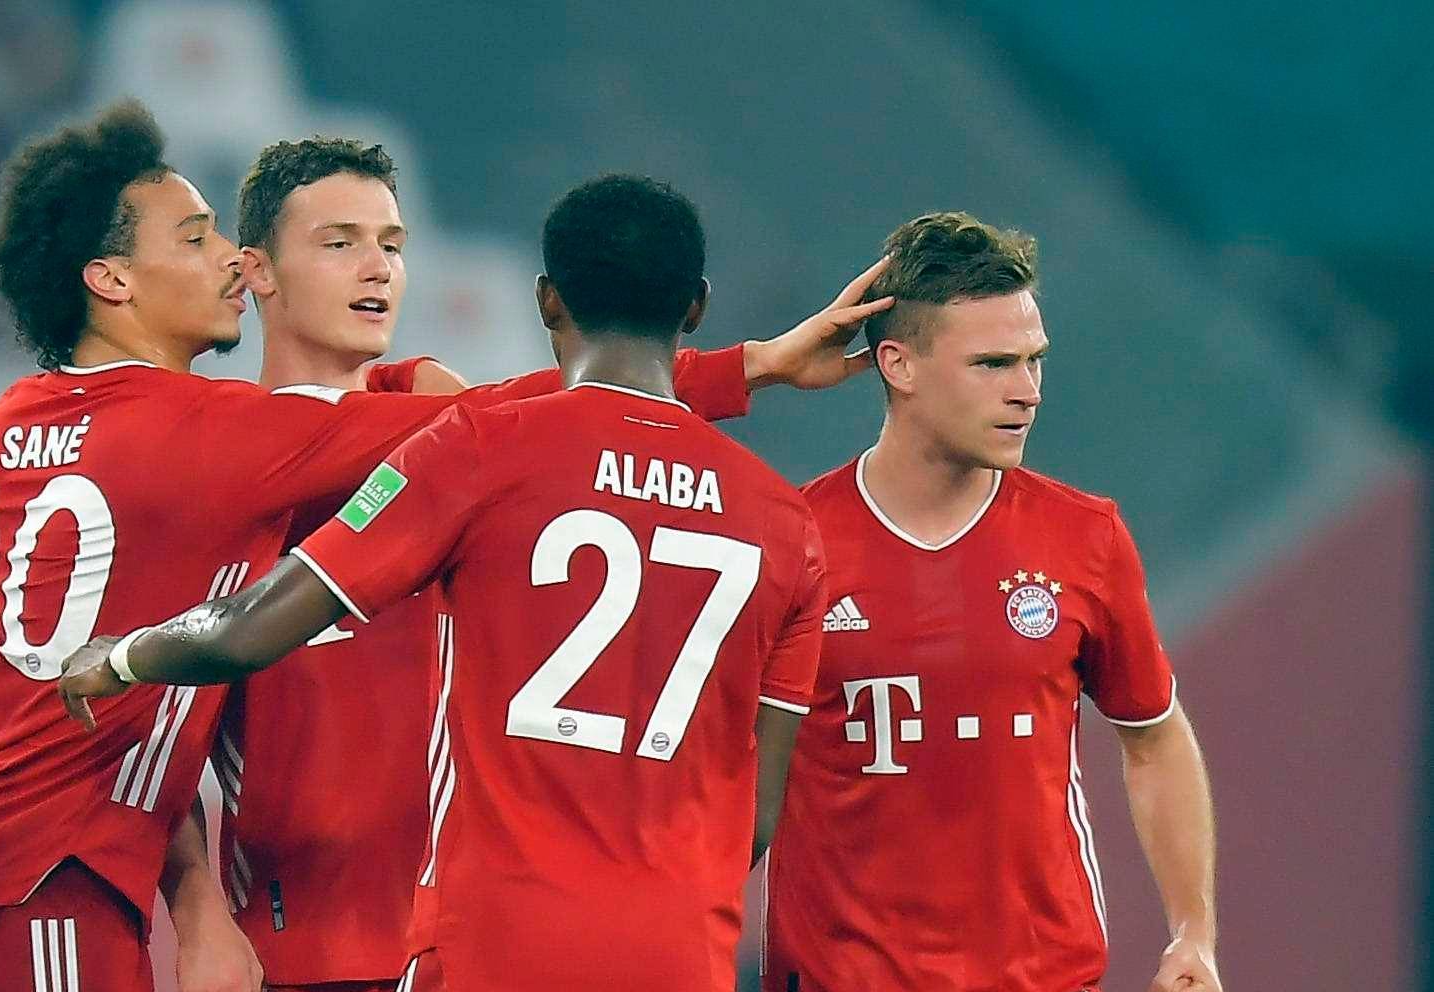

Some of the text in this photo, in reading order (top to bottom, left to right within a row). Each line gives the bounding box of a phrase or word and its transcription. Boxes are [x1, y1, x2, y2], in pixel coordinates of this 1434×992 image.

[0, 414, 92, 471] SANÉ
[594, 448, 724, 514] ALABA
[505, 509, 763, 762] 27
